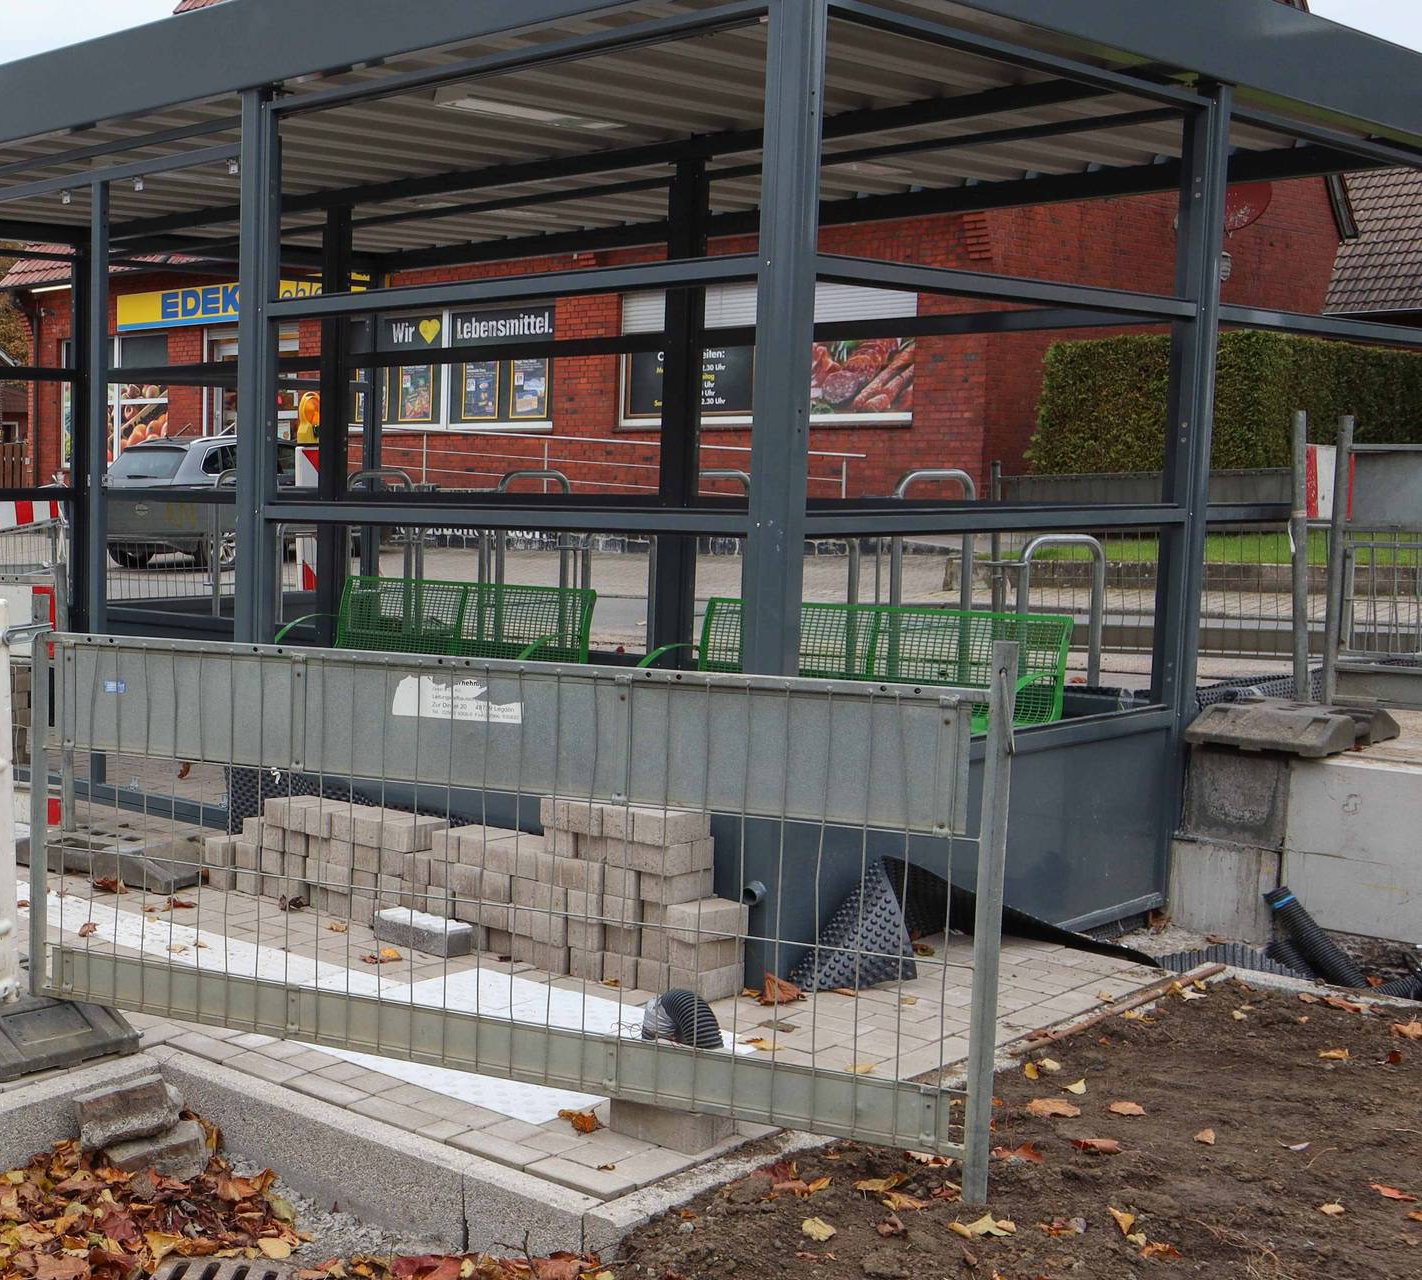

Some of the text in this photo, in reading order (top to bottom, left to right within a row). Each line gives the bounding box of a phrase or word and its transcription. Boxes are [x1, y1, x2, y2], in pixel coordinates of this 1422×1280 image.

[162, 286, 240, 319] EDEK
[392, 311, 553, 344] Wir Lebensmittel.
